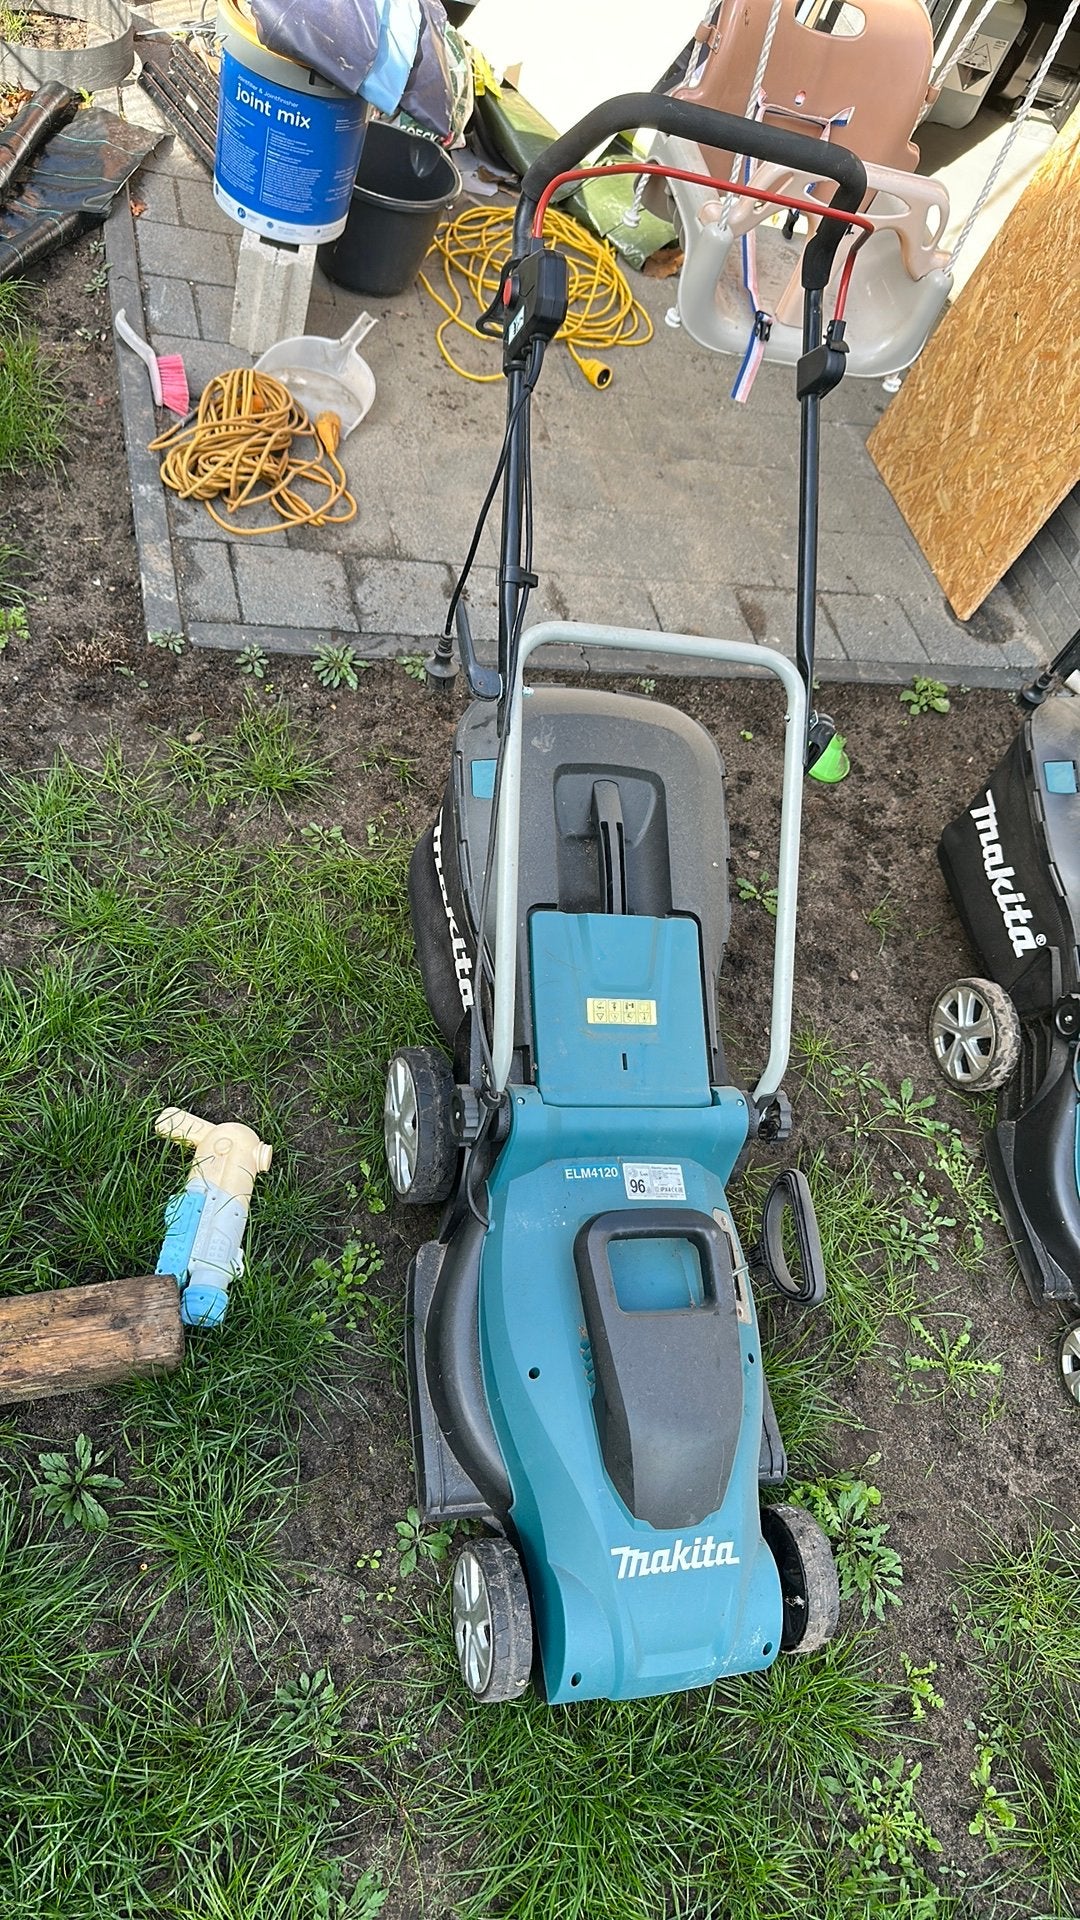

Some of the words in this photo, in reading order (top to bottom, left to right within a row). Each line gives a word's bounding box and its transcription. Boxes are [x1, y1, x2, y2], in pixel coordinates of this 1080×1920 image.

[236, 82, 272, 117] joint
[277, 109, 311, 130] mix
[564, 1166, 619, 1179] ELM4120
[629, 1178, 646, 1193] 96
